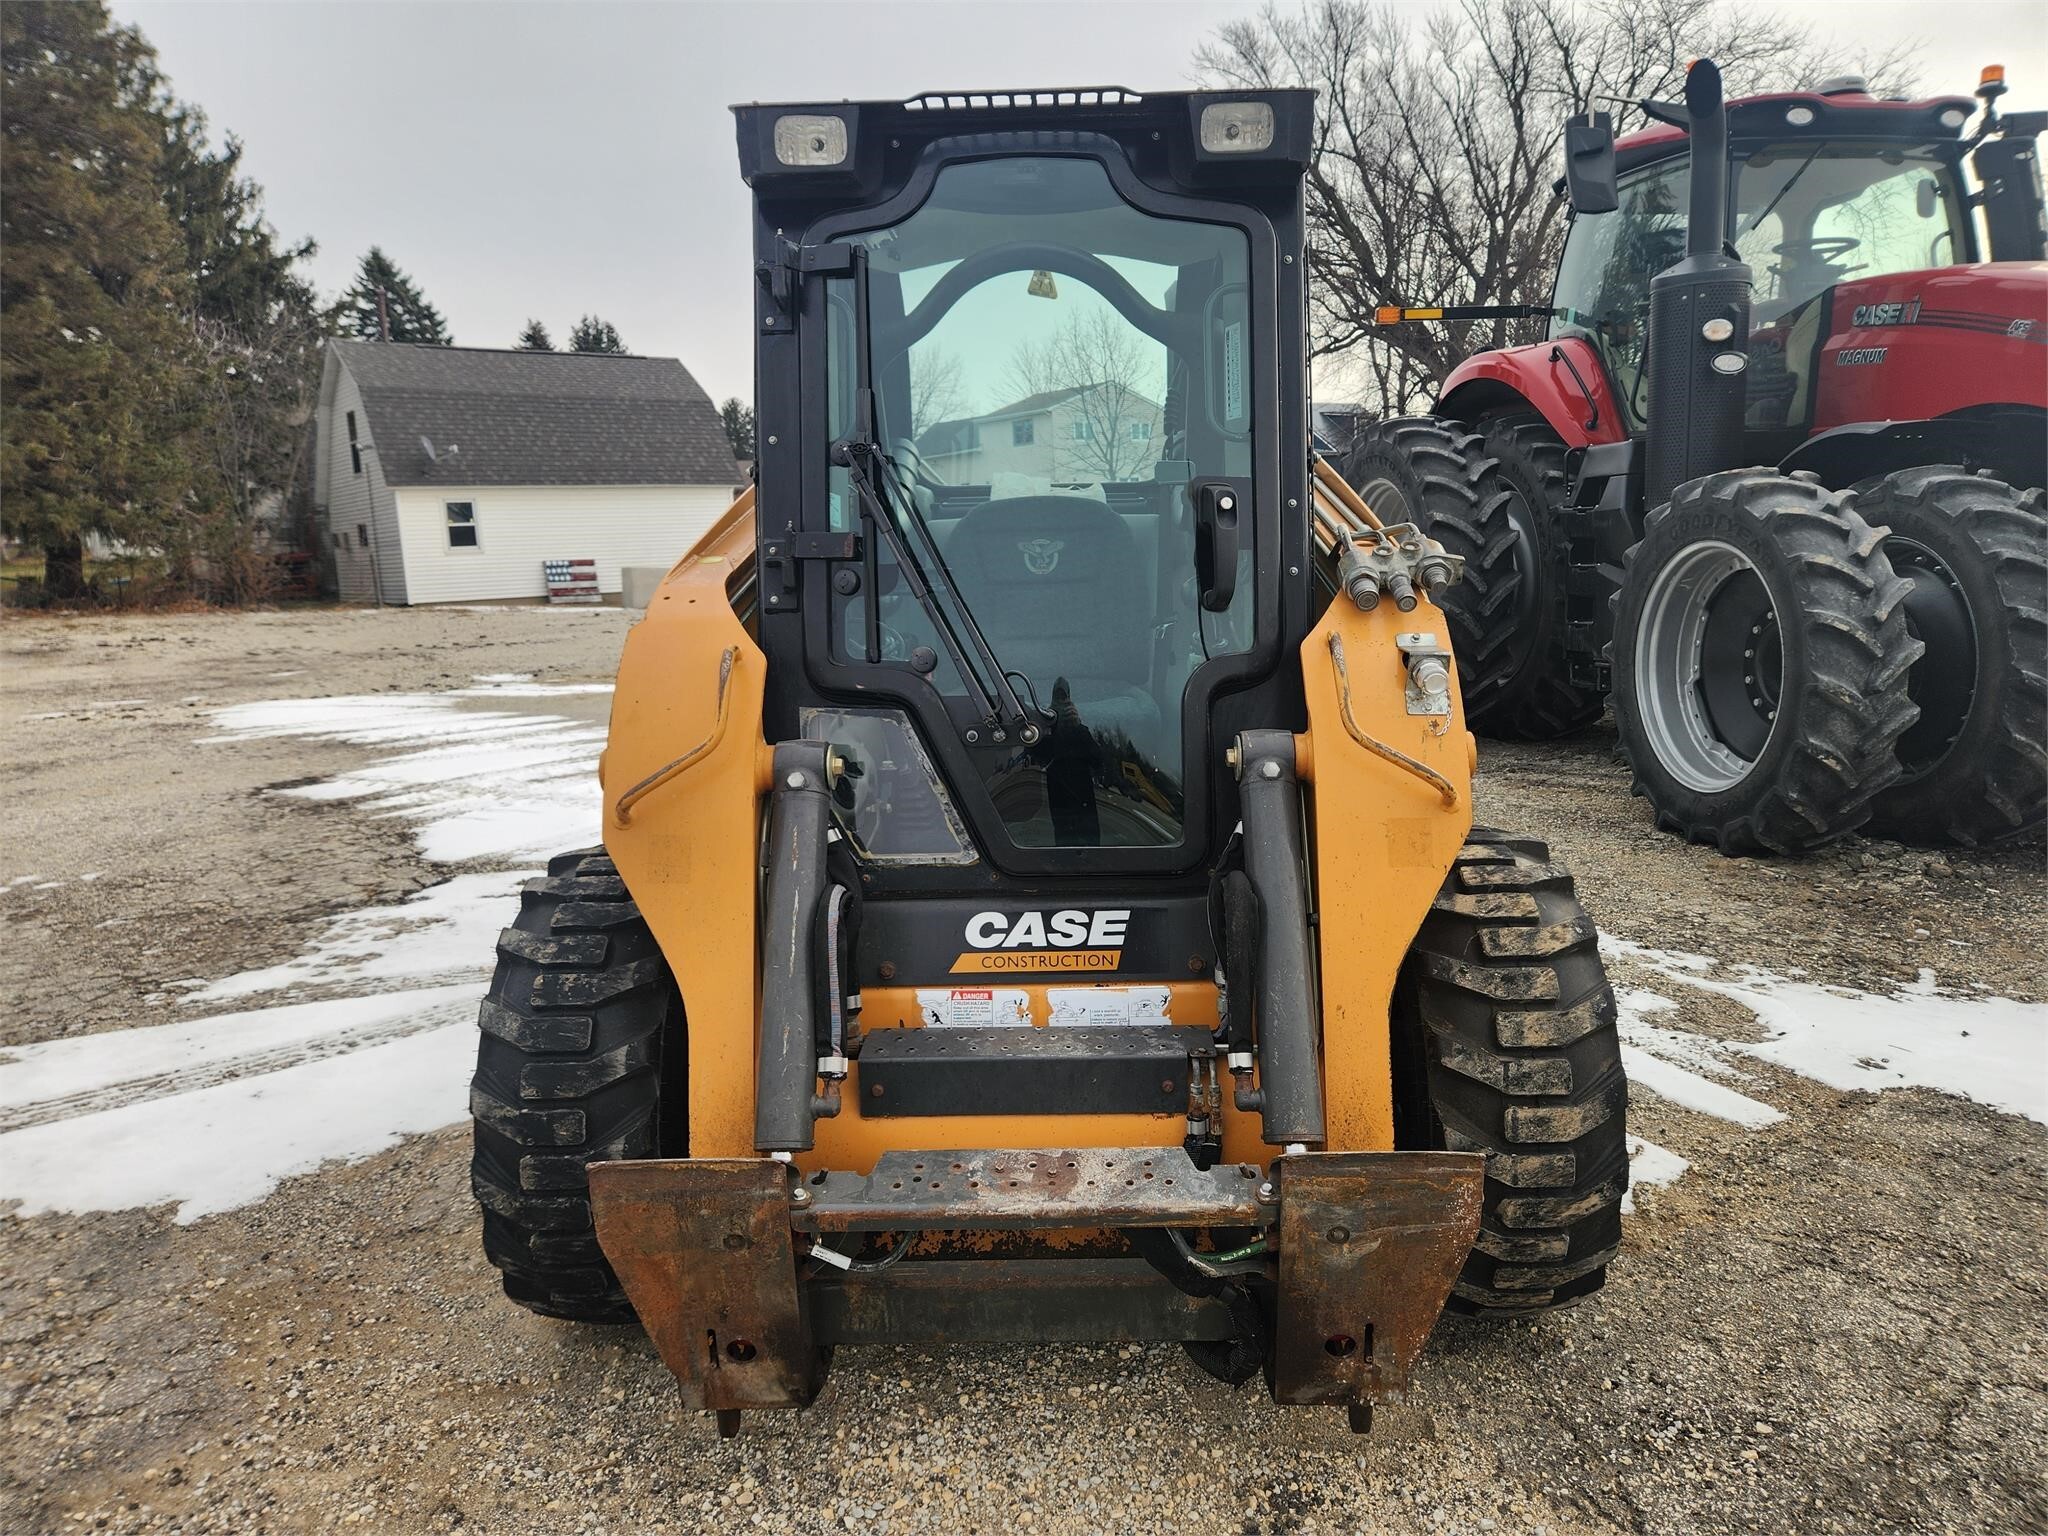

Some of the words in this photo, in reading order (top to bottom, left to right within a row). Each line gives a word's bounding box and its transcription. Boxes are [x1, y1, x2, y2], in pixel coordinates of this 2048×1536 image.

[1836, 347, 1888, 366] MAGNUM
[964, 909, 1131, 949] CASE
[981, 953, 1114, 969] CONSTRUCTION
